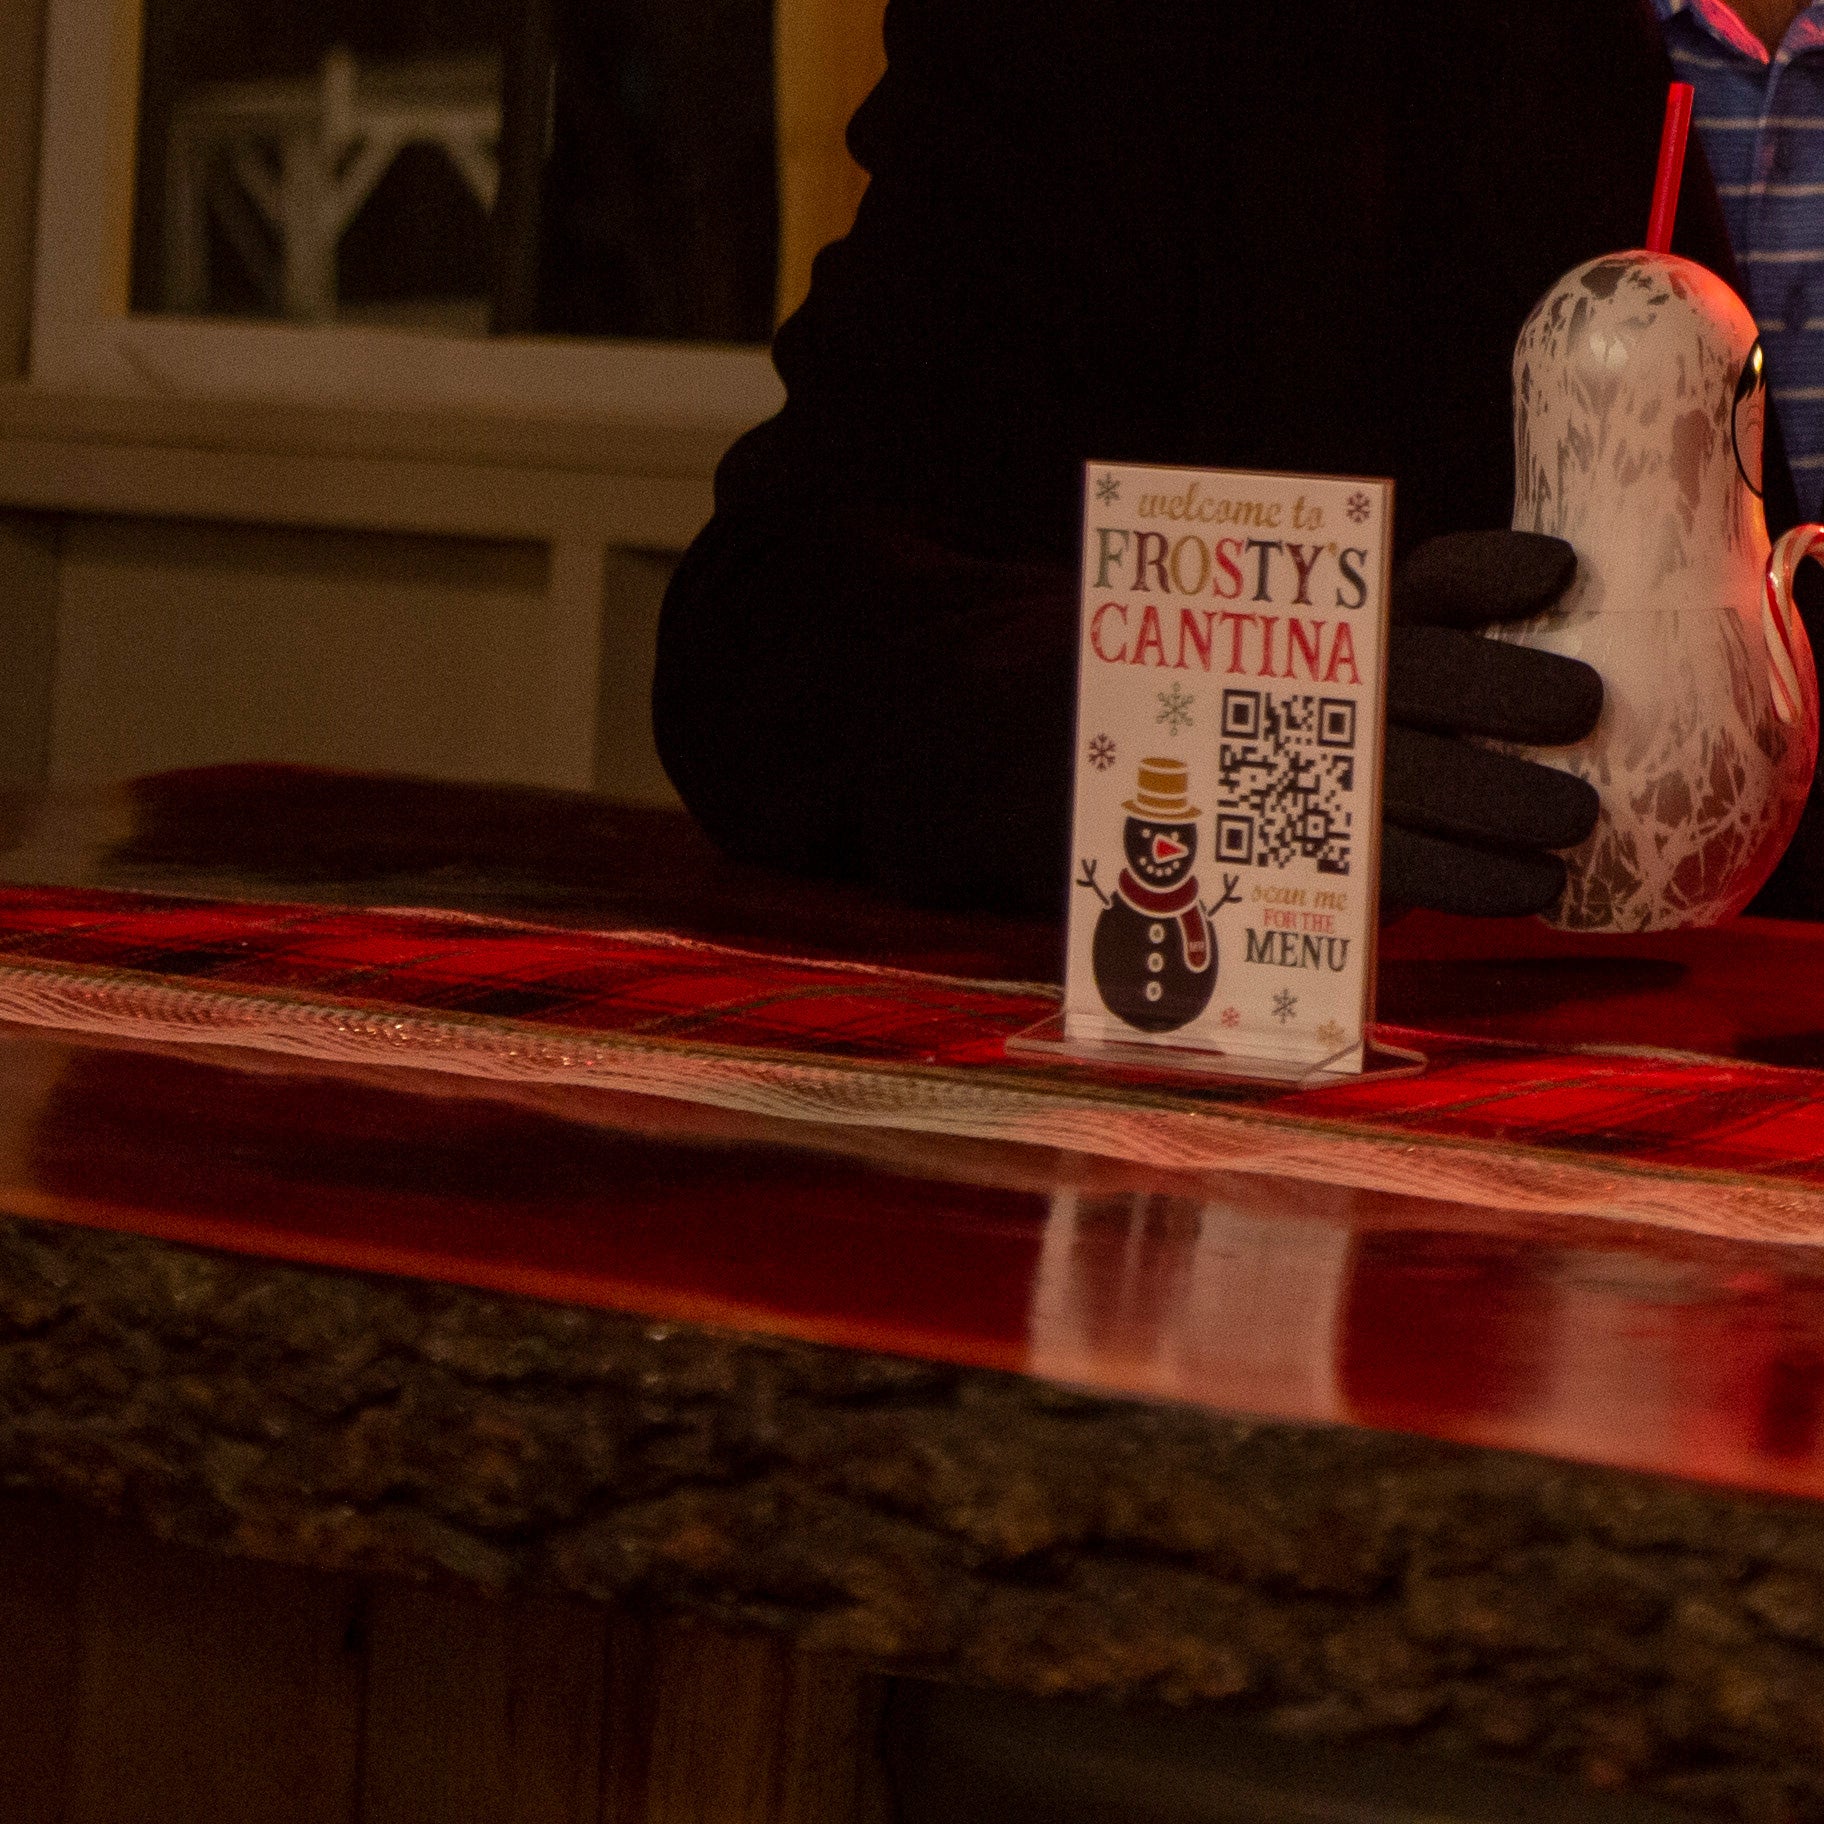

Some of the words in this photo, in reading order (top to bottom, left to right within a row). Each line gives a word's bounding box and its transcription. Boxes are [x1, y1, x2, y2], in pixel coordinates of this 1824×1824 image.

[1137, 481, 1282, 527] welcome
[1291, 495, 1325, 531] to
[1093, 527, 1368, 610] FROSTY'S
[1089, 601, 1363, 686] CANTINA
[1251, 884, 1307, 907] scan
[1313, 890, 1348, 912] me
[1263, 908, 1297, 929] FOR
[1301, 912, 1335, 935] THE
[1244, 927, 1350, 973] MENU
